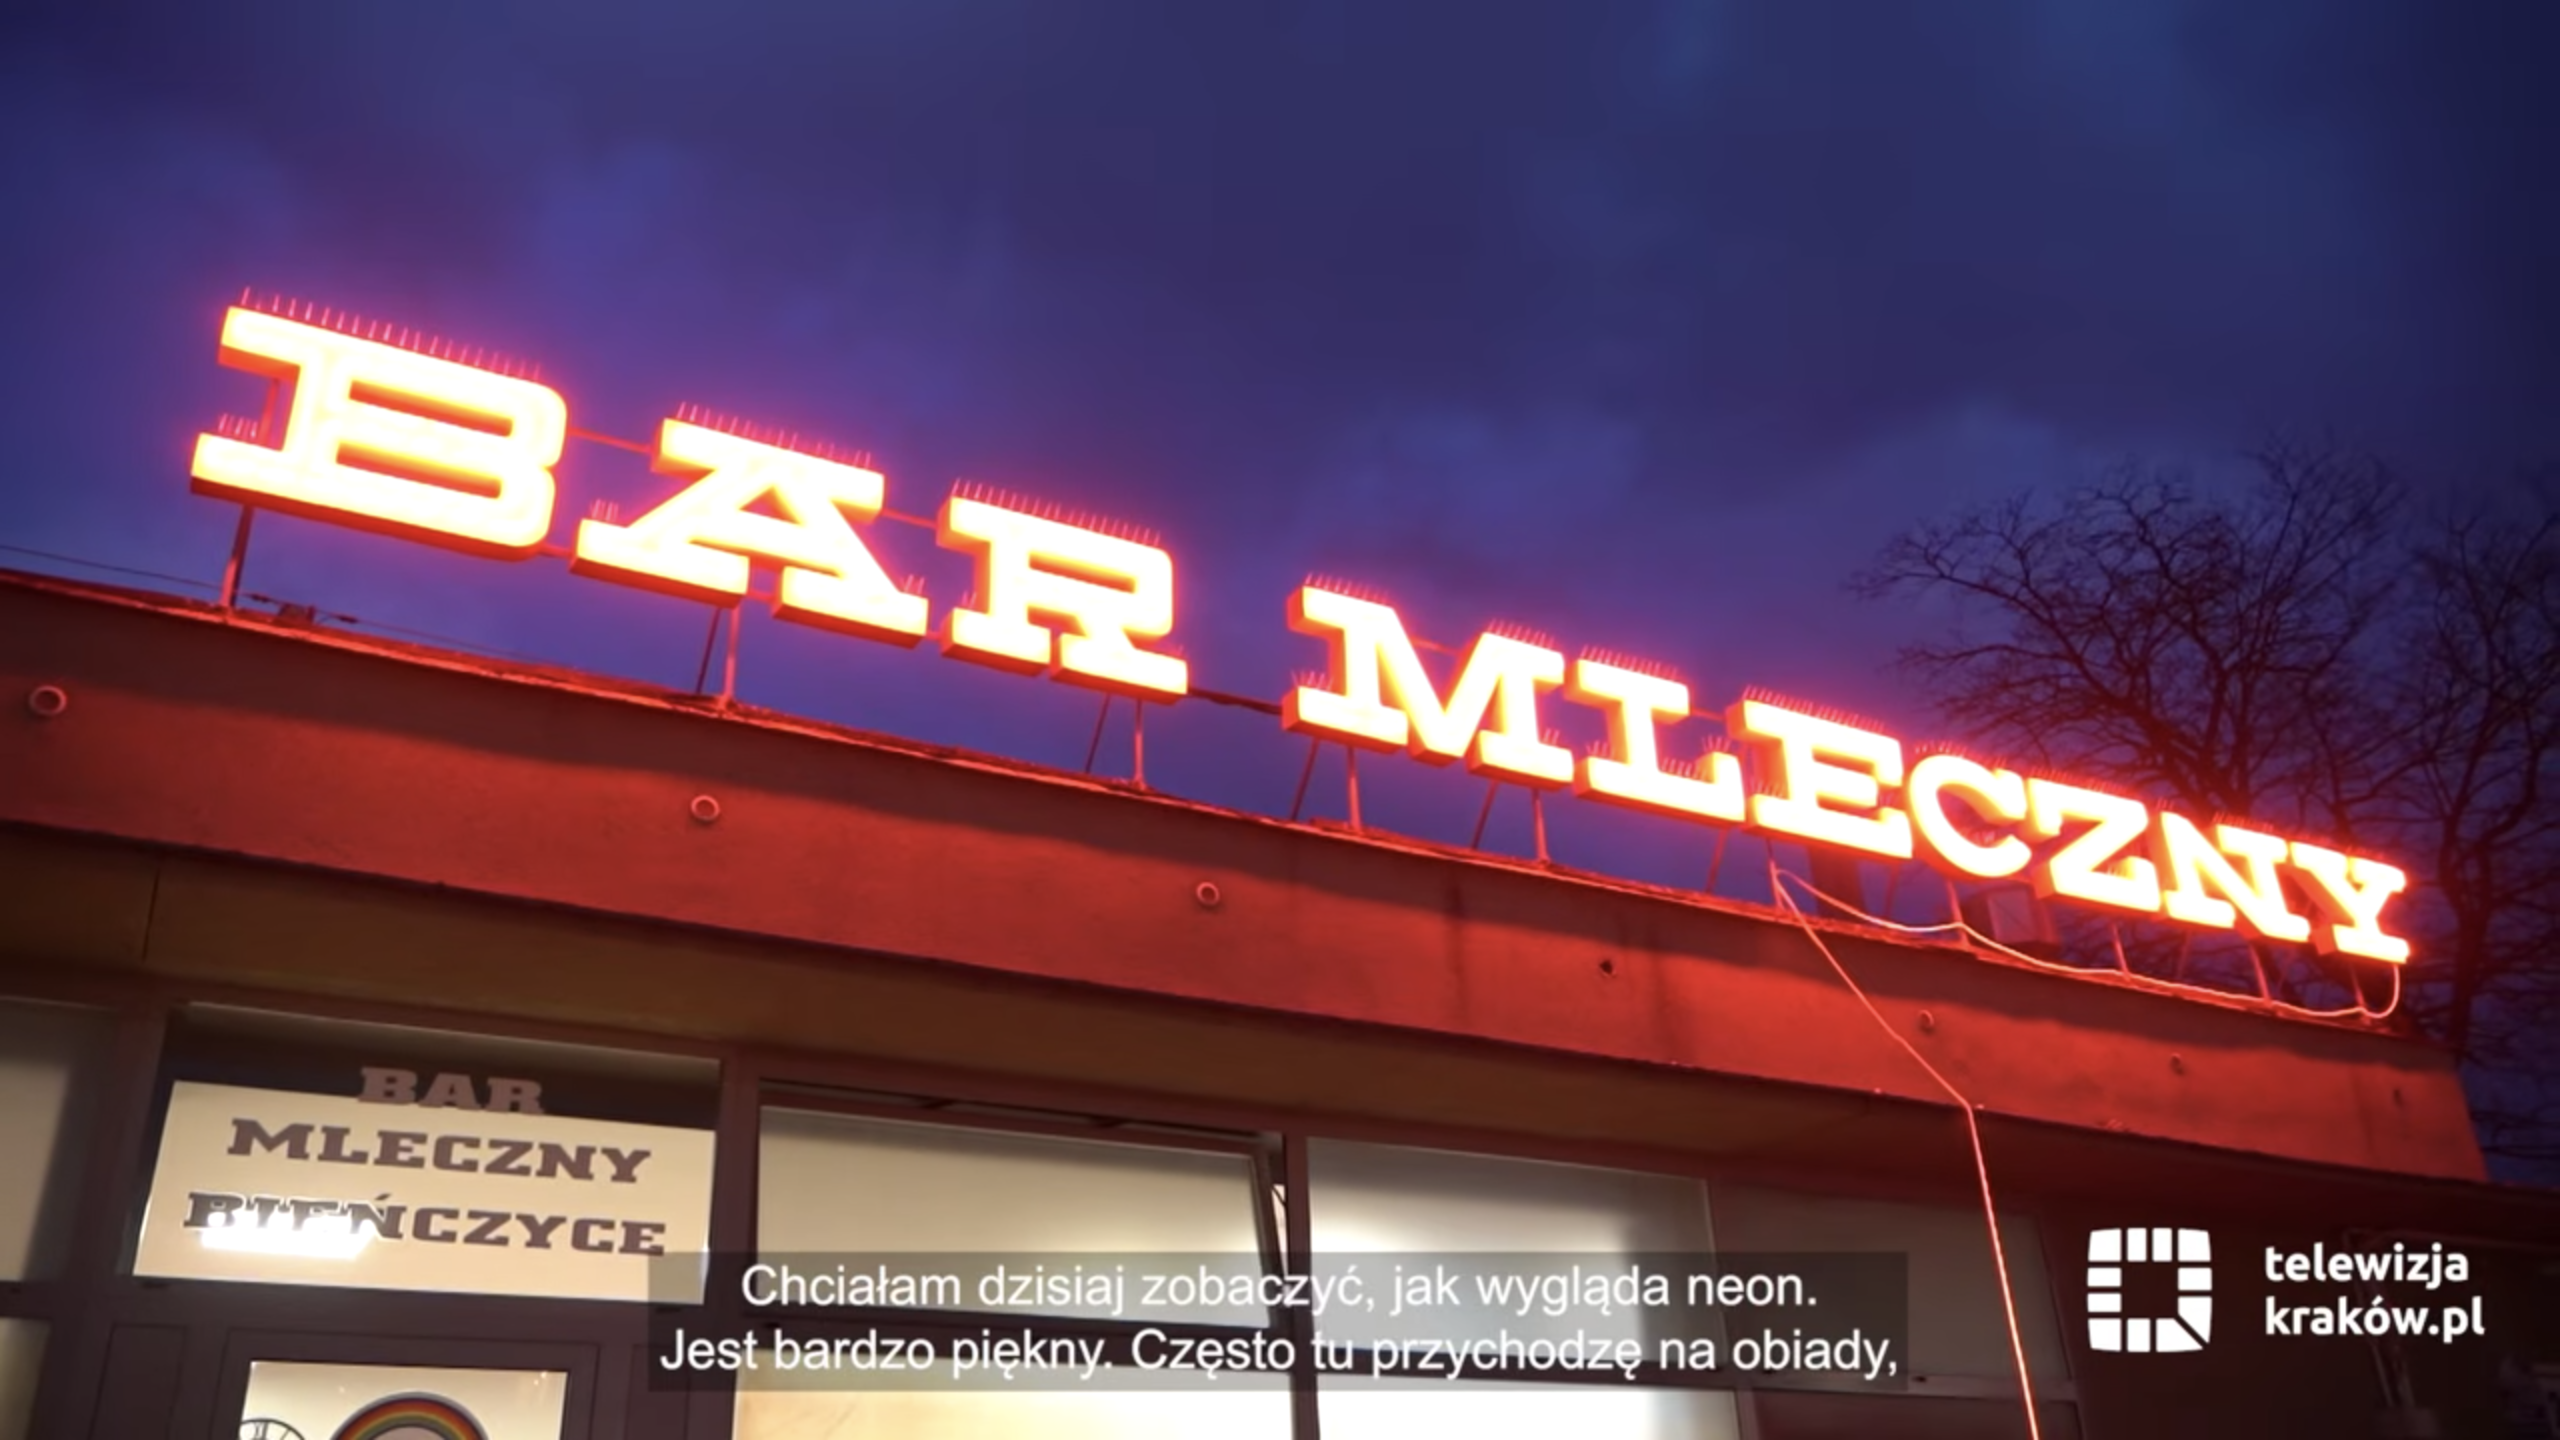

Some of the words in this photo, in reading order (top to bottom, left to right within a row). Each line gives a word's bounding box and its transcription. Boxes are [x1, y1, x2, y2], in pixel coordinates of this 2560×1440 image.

[190, 304, 1189, 704] BAR
[1283, 583, 2411, 963] MLECZNY
[357, 1065, 546, 1116] BAR
[226, 1117, 652, 1184] MLECZNY
